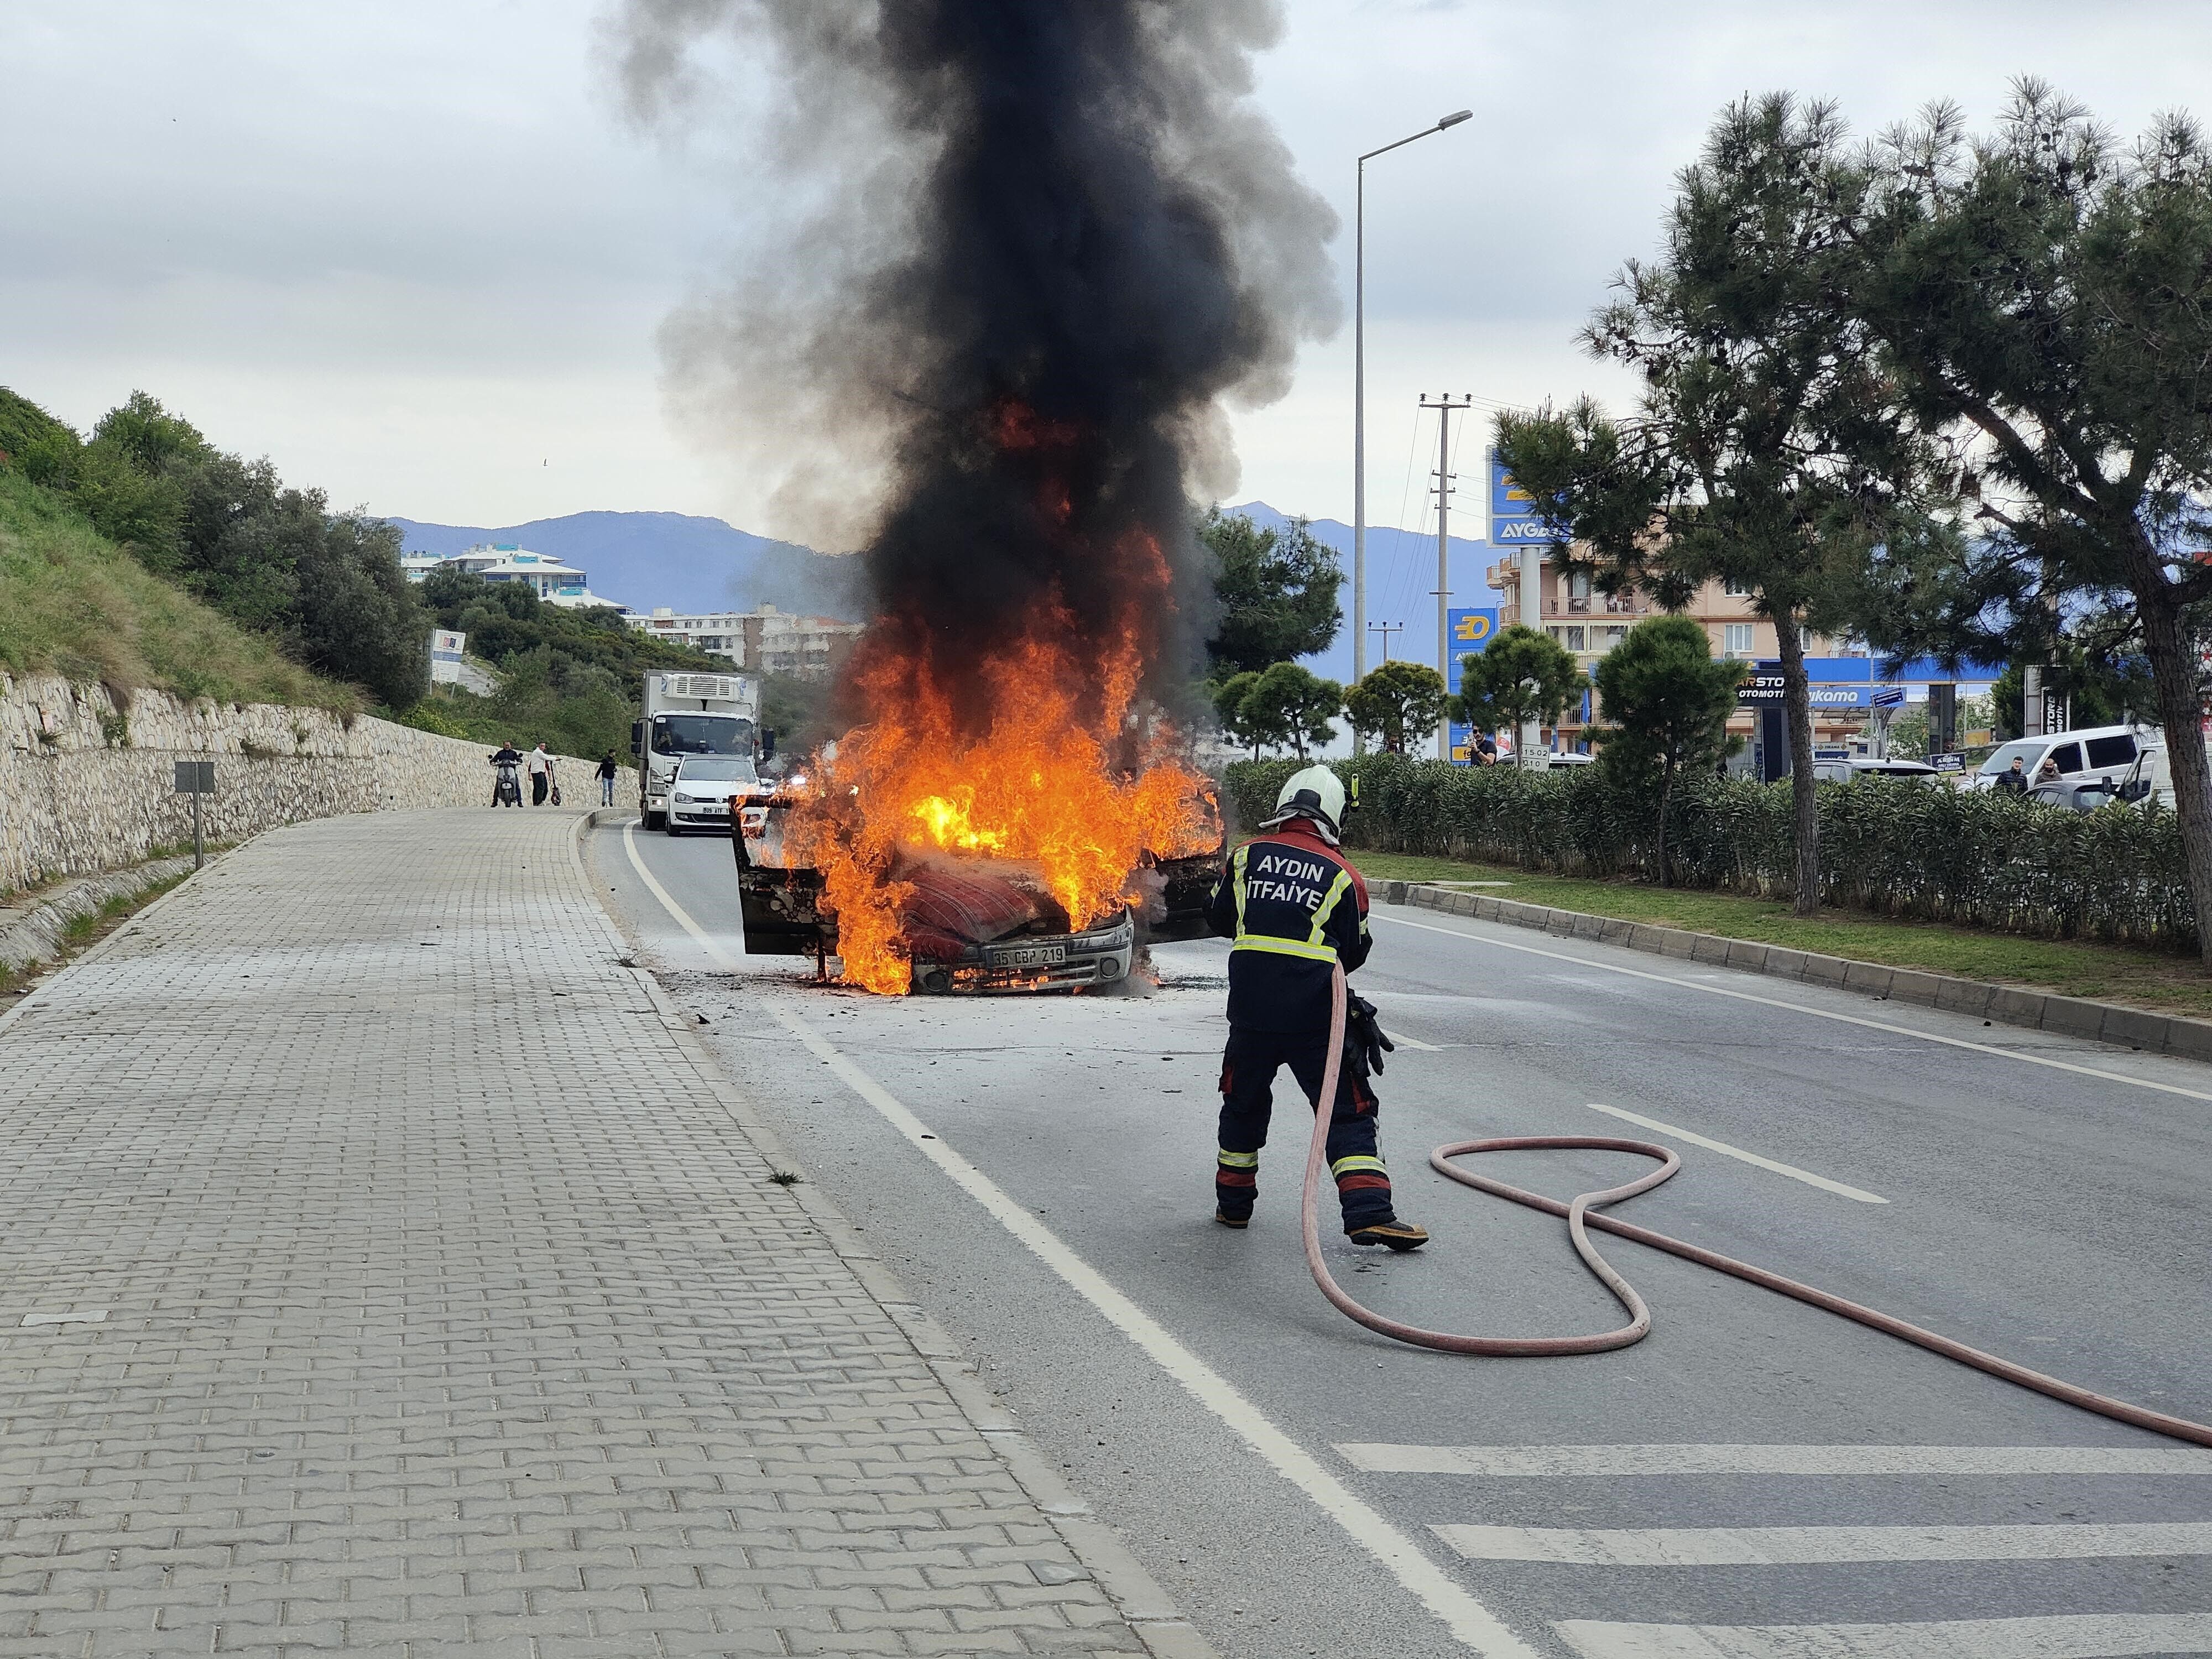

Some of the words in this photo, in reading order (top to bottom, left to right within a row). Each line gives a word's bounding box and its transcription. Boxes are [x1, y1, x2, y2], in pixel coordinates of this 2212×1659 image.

[1735, 677, 1785, 687] ARSTO
[1739, 689, 1786, 698] OTOMOTİ
[1257, 855, 1324, 883] AYDIN
[1246, 875, 1323, 911] İTFAİYE
[994, 952, 1008, 965] 35
[1041, 948, 1063, 962] 219
